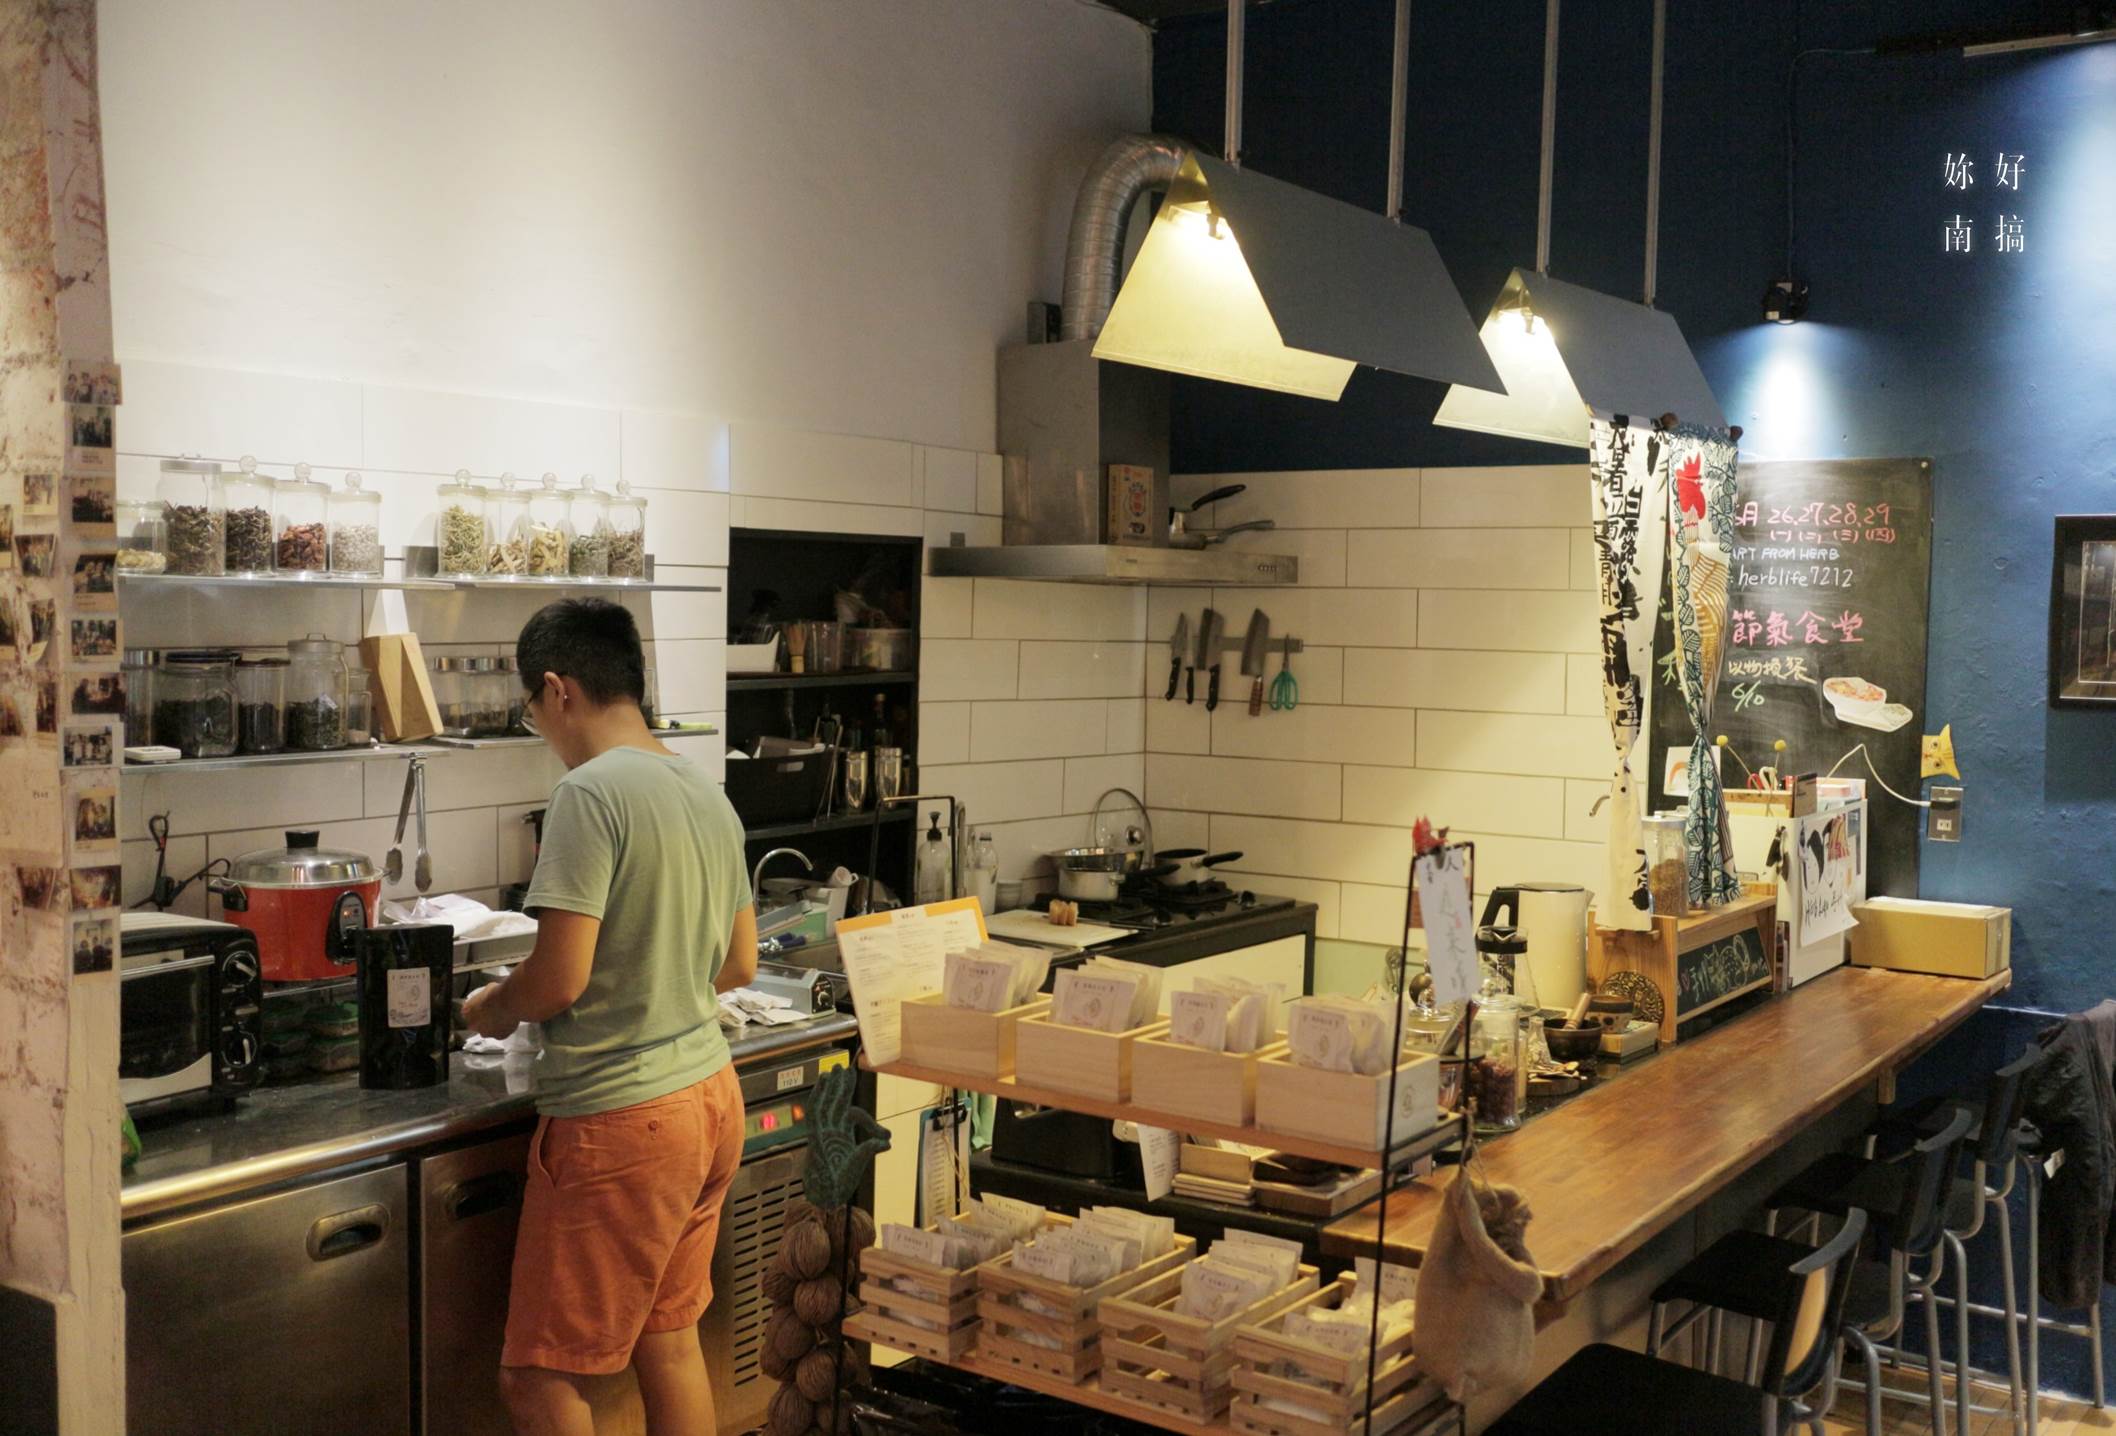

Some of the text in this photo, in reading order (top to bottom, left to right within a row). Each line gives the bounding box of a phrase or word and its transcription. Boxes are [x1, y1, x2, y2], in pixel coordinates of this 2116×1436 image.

[1943, 214, 2025, 253] 南搞
[1761, 547, 1796, 561] FROM
[1799, 547, 1840, 561] HERB
[1731, 609, 1865, 647] 節氣食堂
[1731, 680, 1766, 713] 6/10
